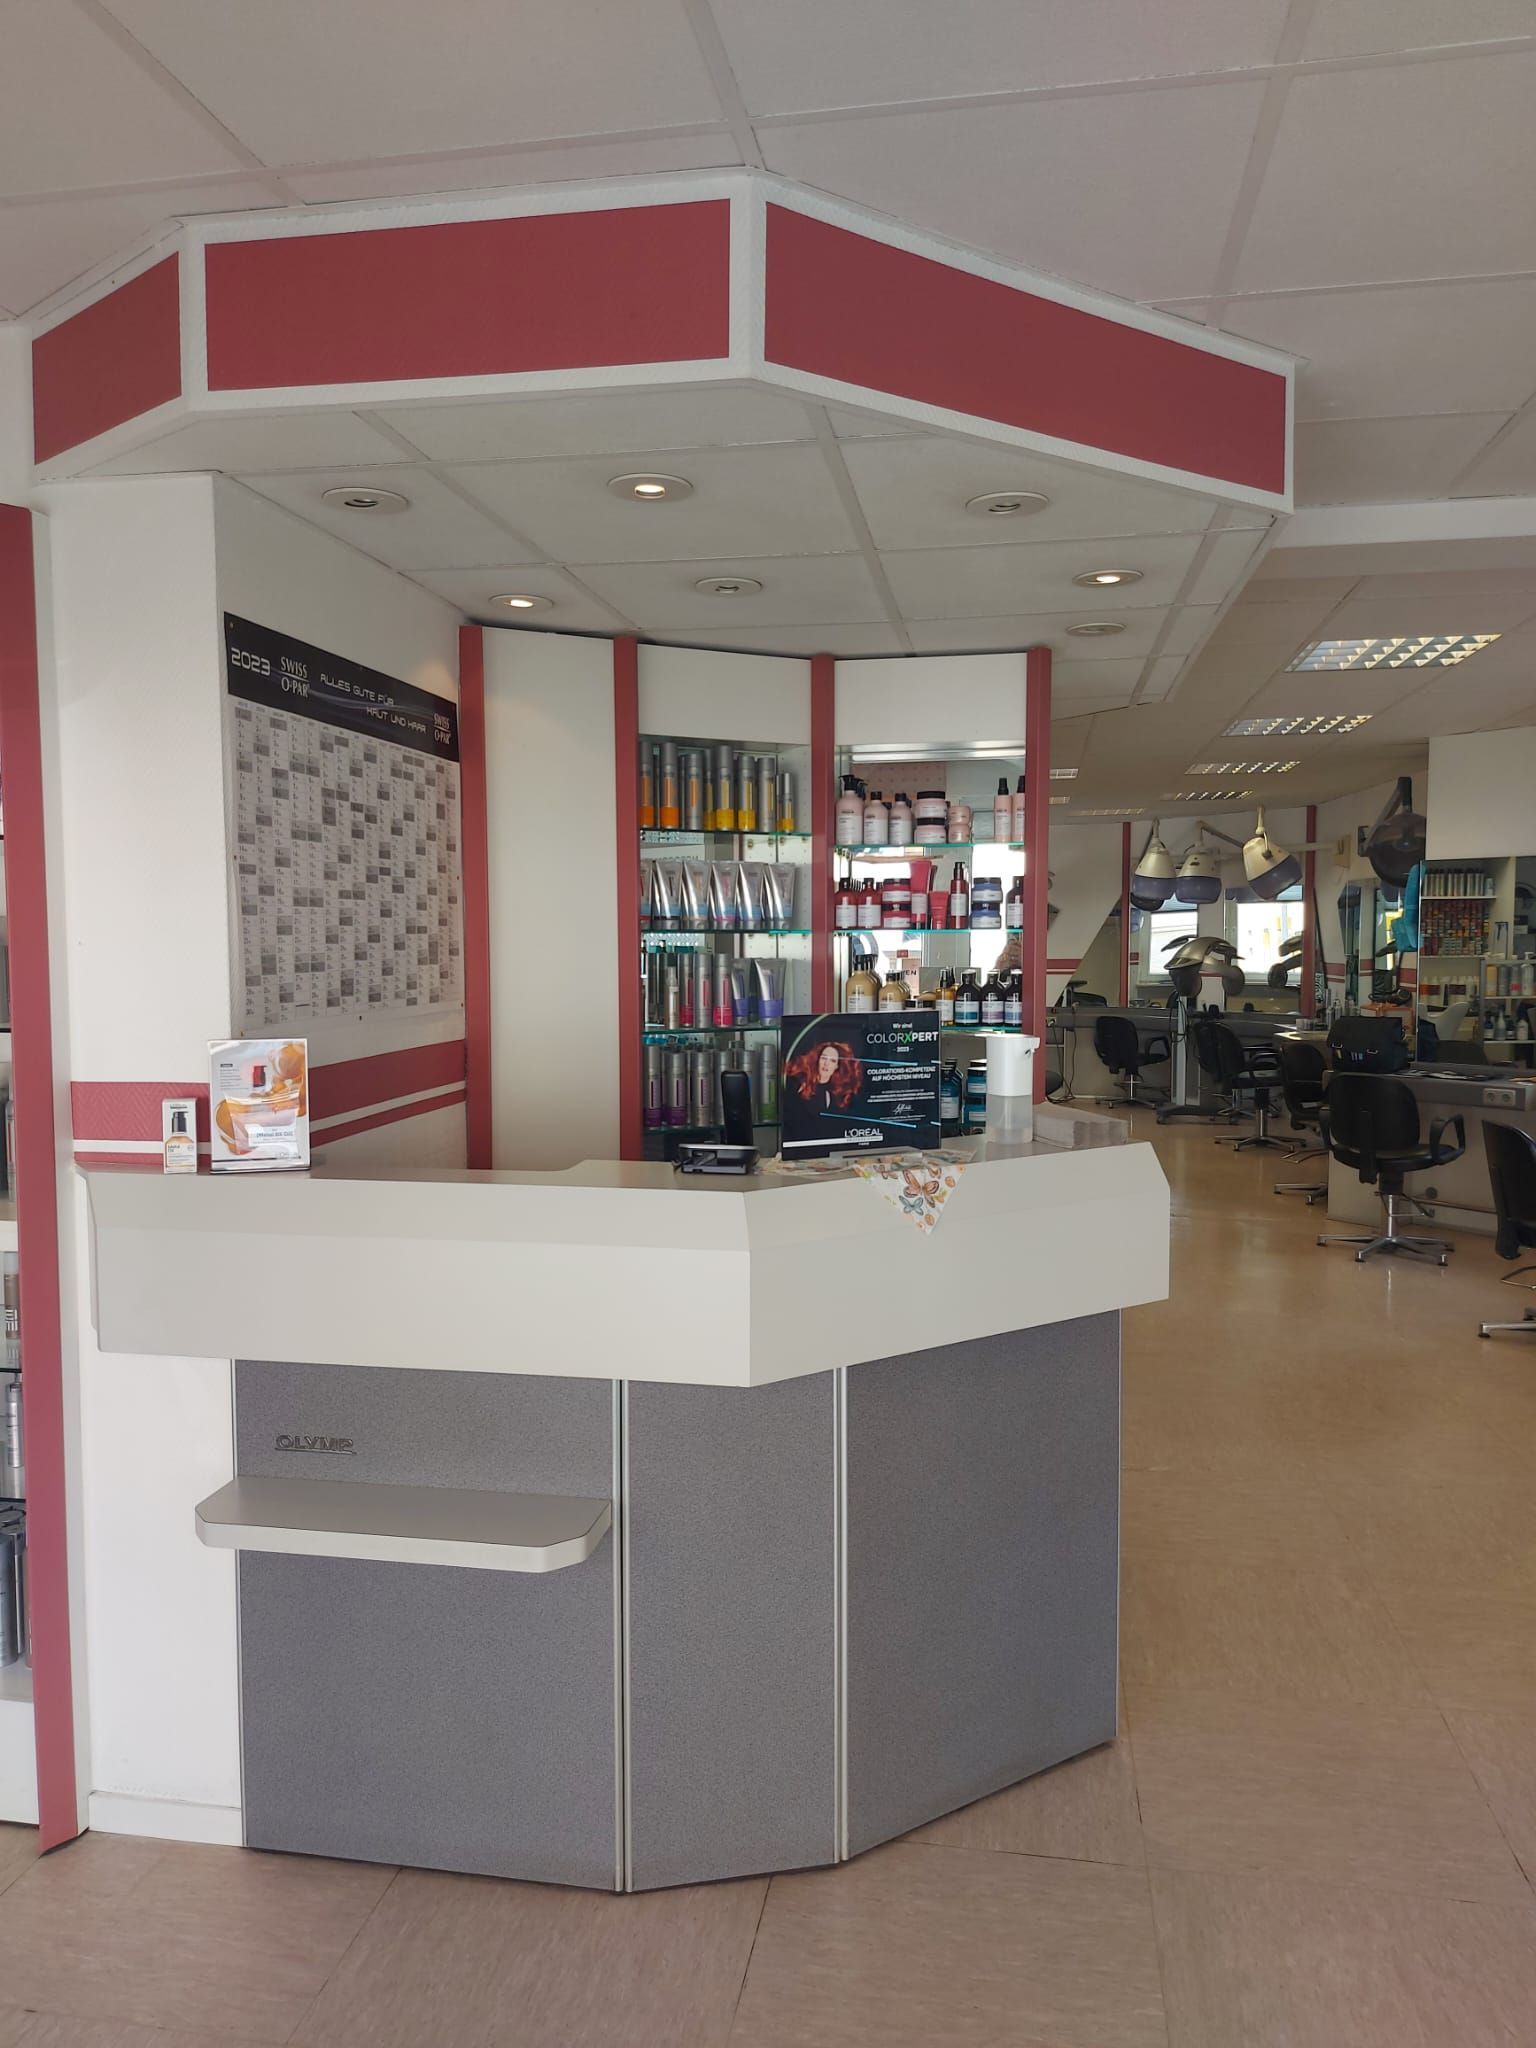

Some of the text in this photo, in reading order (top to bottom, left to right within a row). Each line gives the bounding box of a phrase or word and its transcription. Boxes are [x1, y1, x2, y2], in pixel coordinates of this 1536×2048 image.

[230, 647, 271, 676] 2023
[280, 655, 308, 678] SWISS
[320, 673, 394, 706] ALLES GUTE FÜR
[366, 706, 427, 735] HAUT UND HAAR
[433, 712, 450, 730] SWISS
[866, 1031, 939, 1044] COLORXPERT
